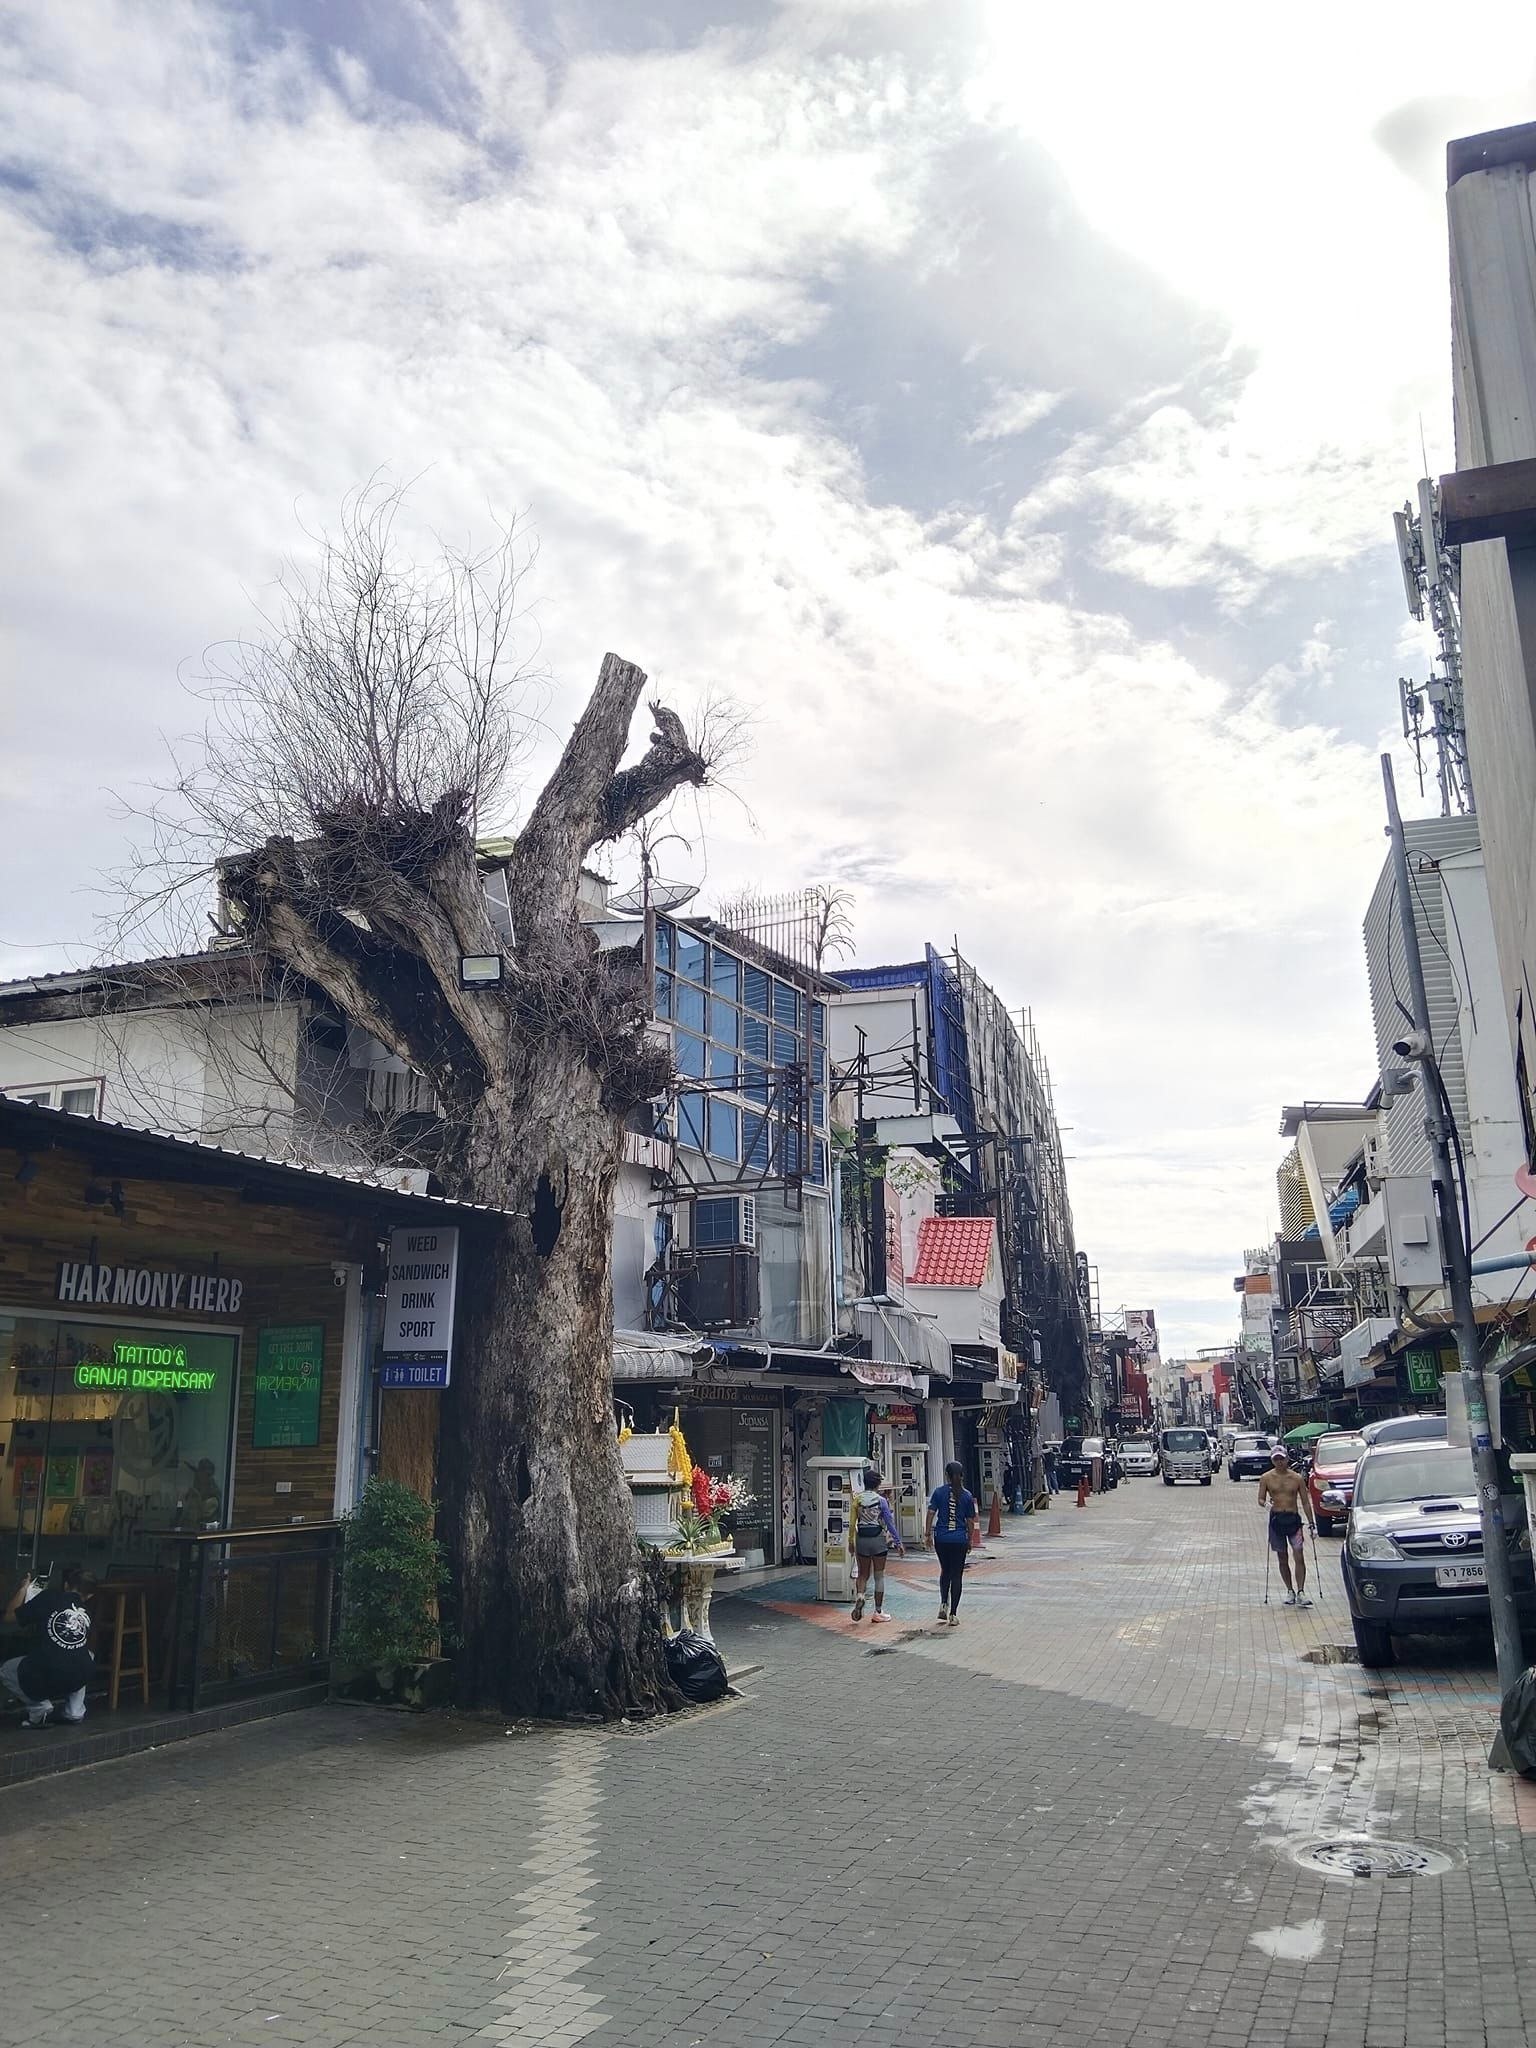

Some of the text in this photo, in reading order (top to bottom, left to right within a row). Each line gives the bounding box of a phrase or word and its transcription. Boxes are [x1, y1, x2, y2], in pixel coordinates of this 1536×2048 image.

[407, 1236, 438, 1252] WEED
[392, 1263, 449, 1281] SANDWICH
[58, 1263, 243, 1313] HARMONY HERB
[401, 1292, 436, 1309] DRINK
[399, 1321, 436, 1338] SPORT
[117, 1345, 185, 1367] TATTOO &
[1411, 1353, 1432, 1369] EXIT
[78, 1366, 216, 1389] GANJA DISPENSARY
[408, 1367, 442, 1383] TOILET
[1460, 1566, 1484, 1577] 7856
